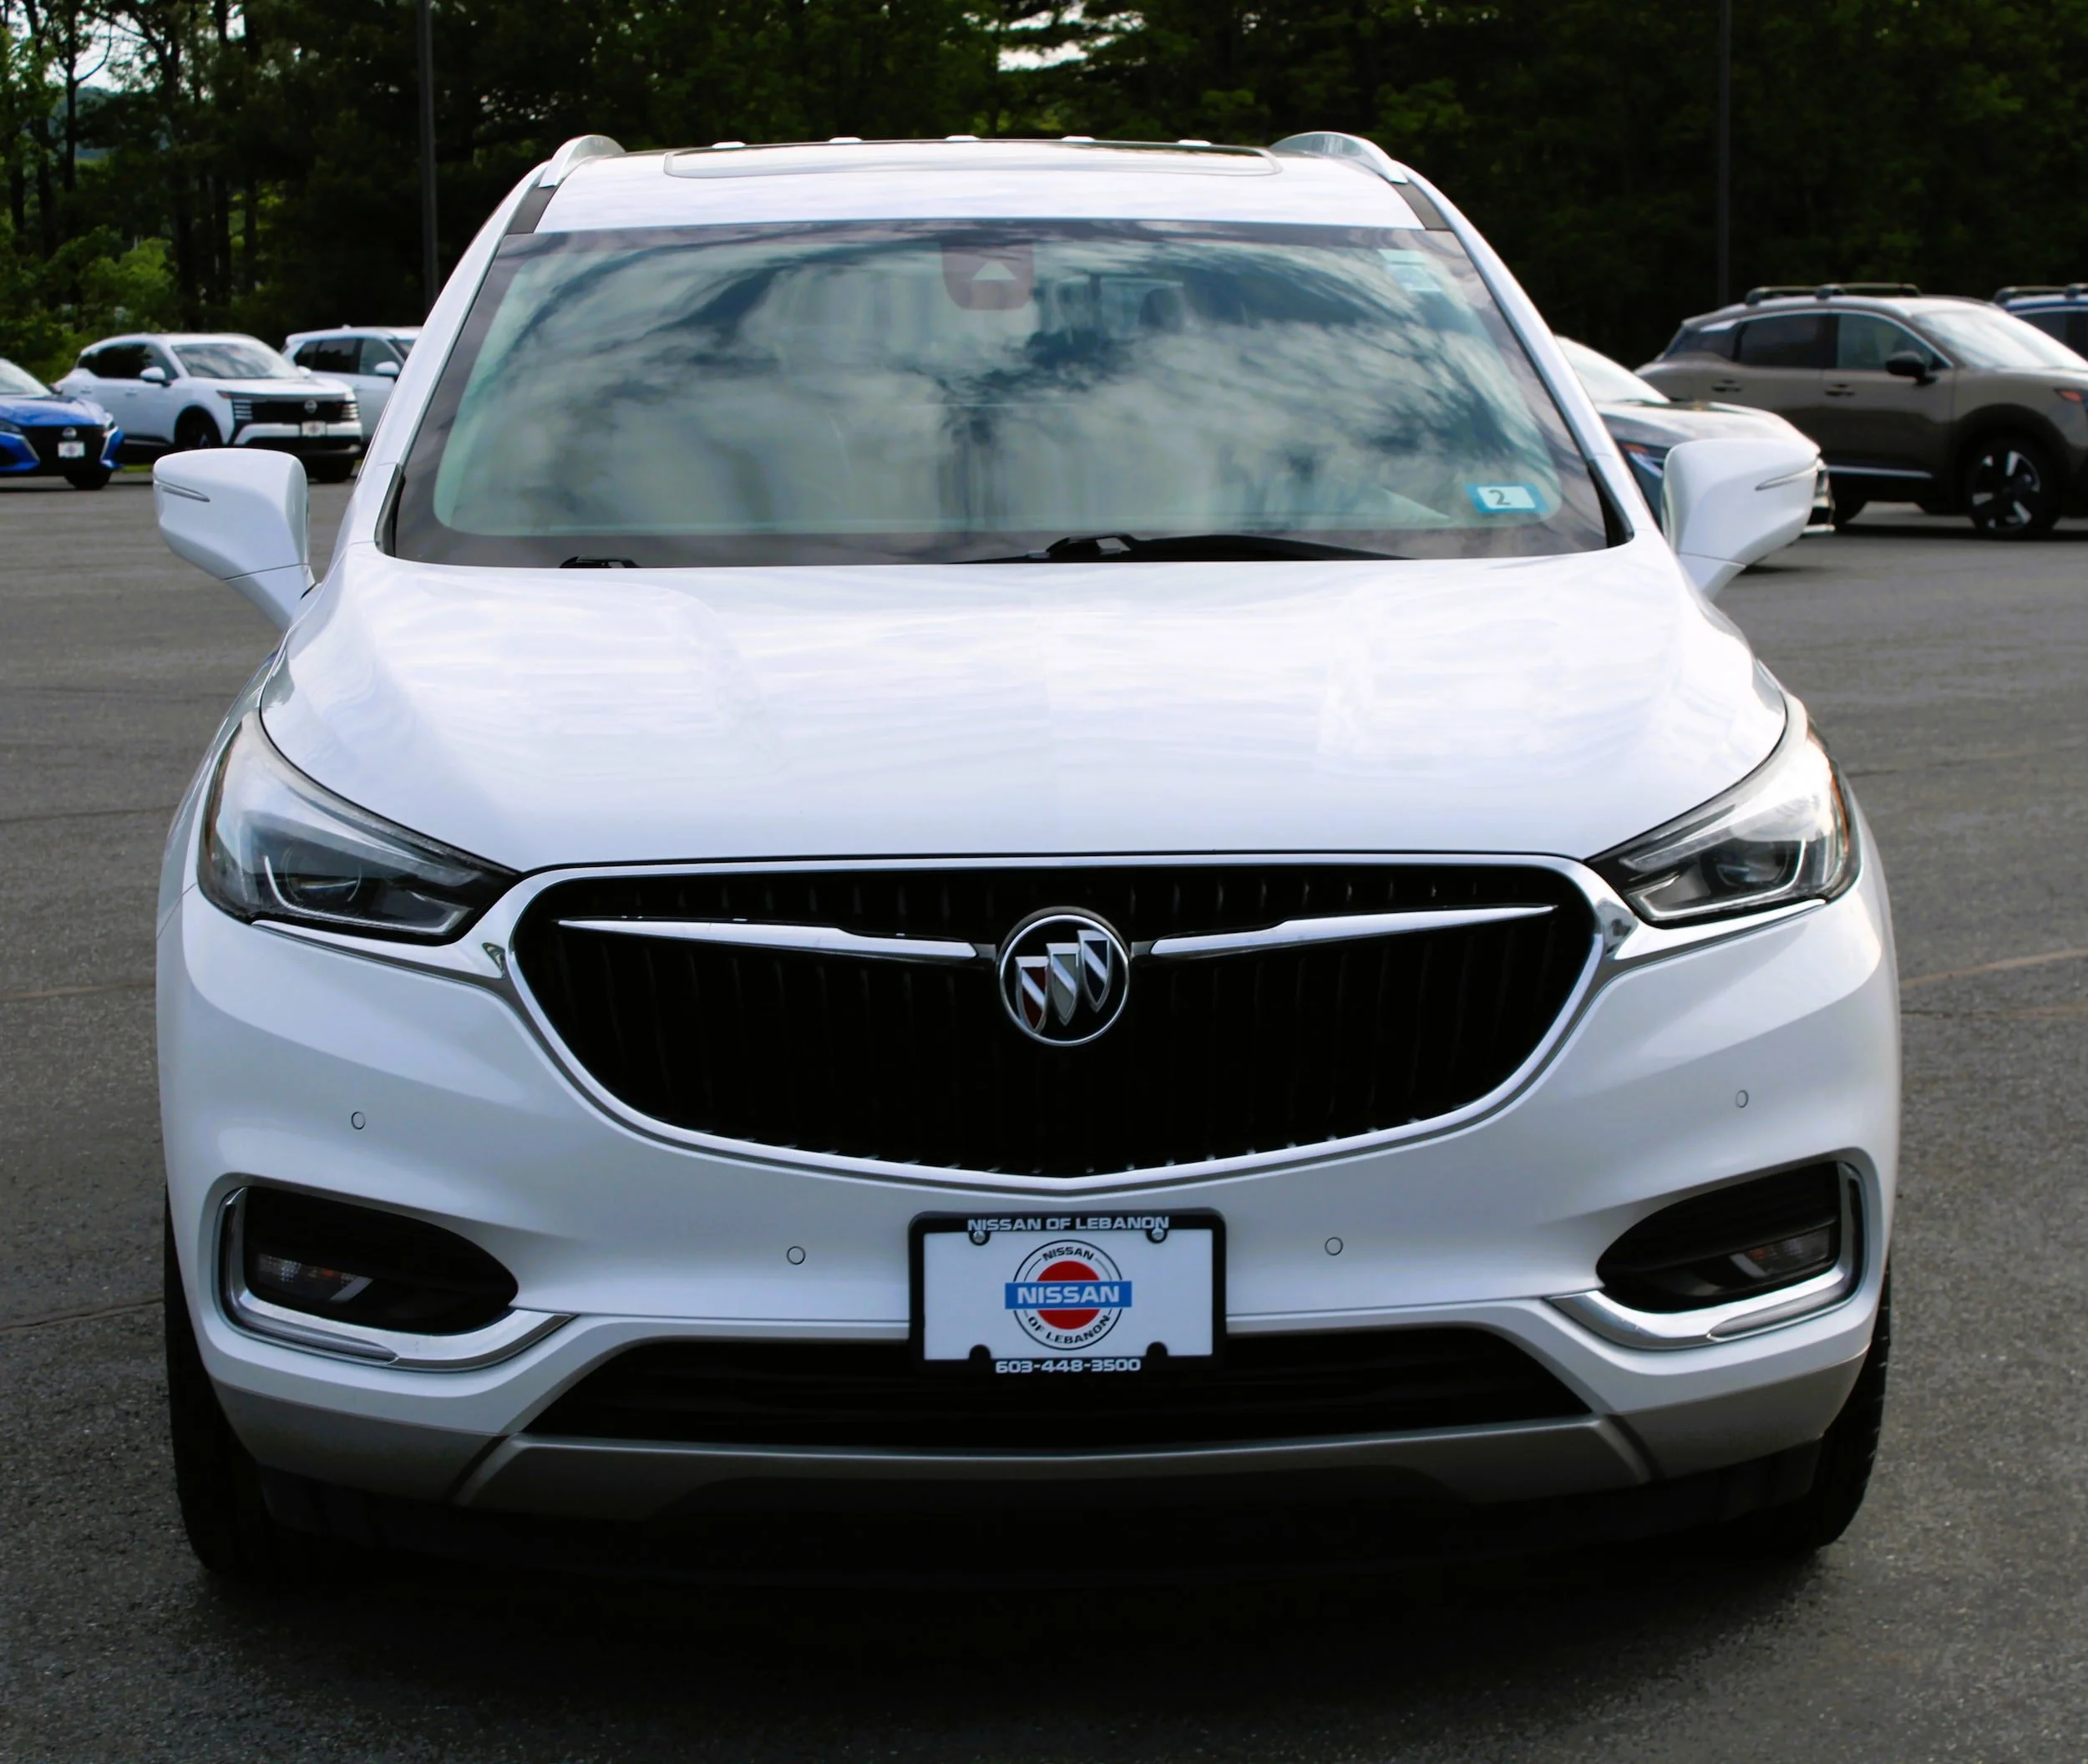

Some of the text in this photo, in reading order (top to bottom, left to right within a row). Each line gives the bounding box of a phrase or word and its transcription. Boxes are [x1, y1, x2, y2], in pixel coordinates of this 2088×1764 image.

[1487, 489, 1511, 506] 2
[967, 1216, 1169, 1231] NISSAN OF LEBANON
[1041, 1246, 1094, 1260] NISSAN
[1016, 1285, 1120, 1305] NISSAN
[1027, 1314, 1111, 1344] OF LEBANON
[995, 1358, 1142, 1374] 603-448-3500
